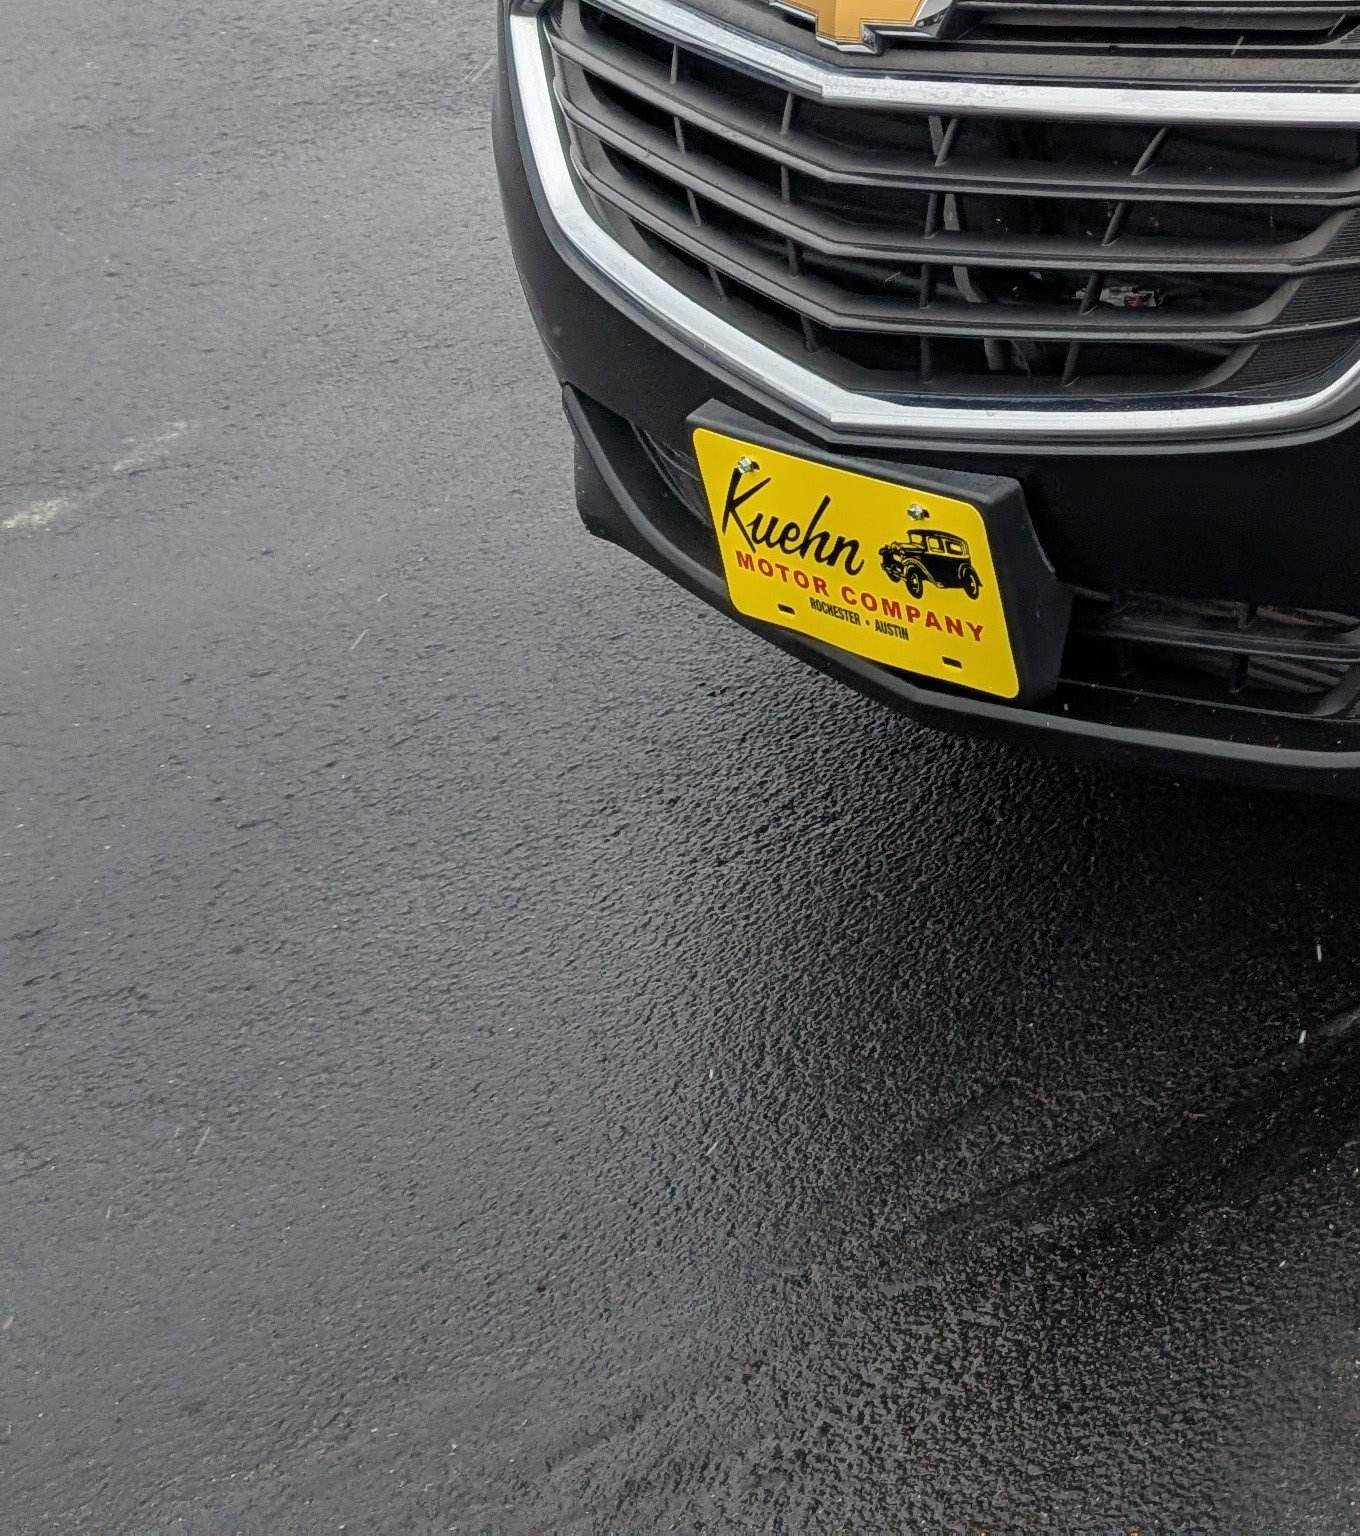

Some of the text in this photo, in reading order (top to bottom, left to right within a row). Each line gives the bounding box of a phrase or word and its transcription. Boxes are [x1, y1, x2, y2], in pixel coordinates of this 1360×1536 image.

[721, 465, 865, 577] Kuehn
[735, 549, 985, 643] MOTOR COMPANY
[810, 596, 909, 641] ROCHESTER AUSTIN
